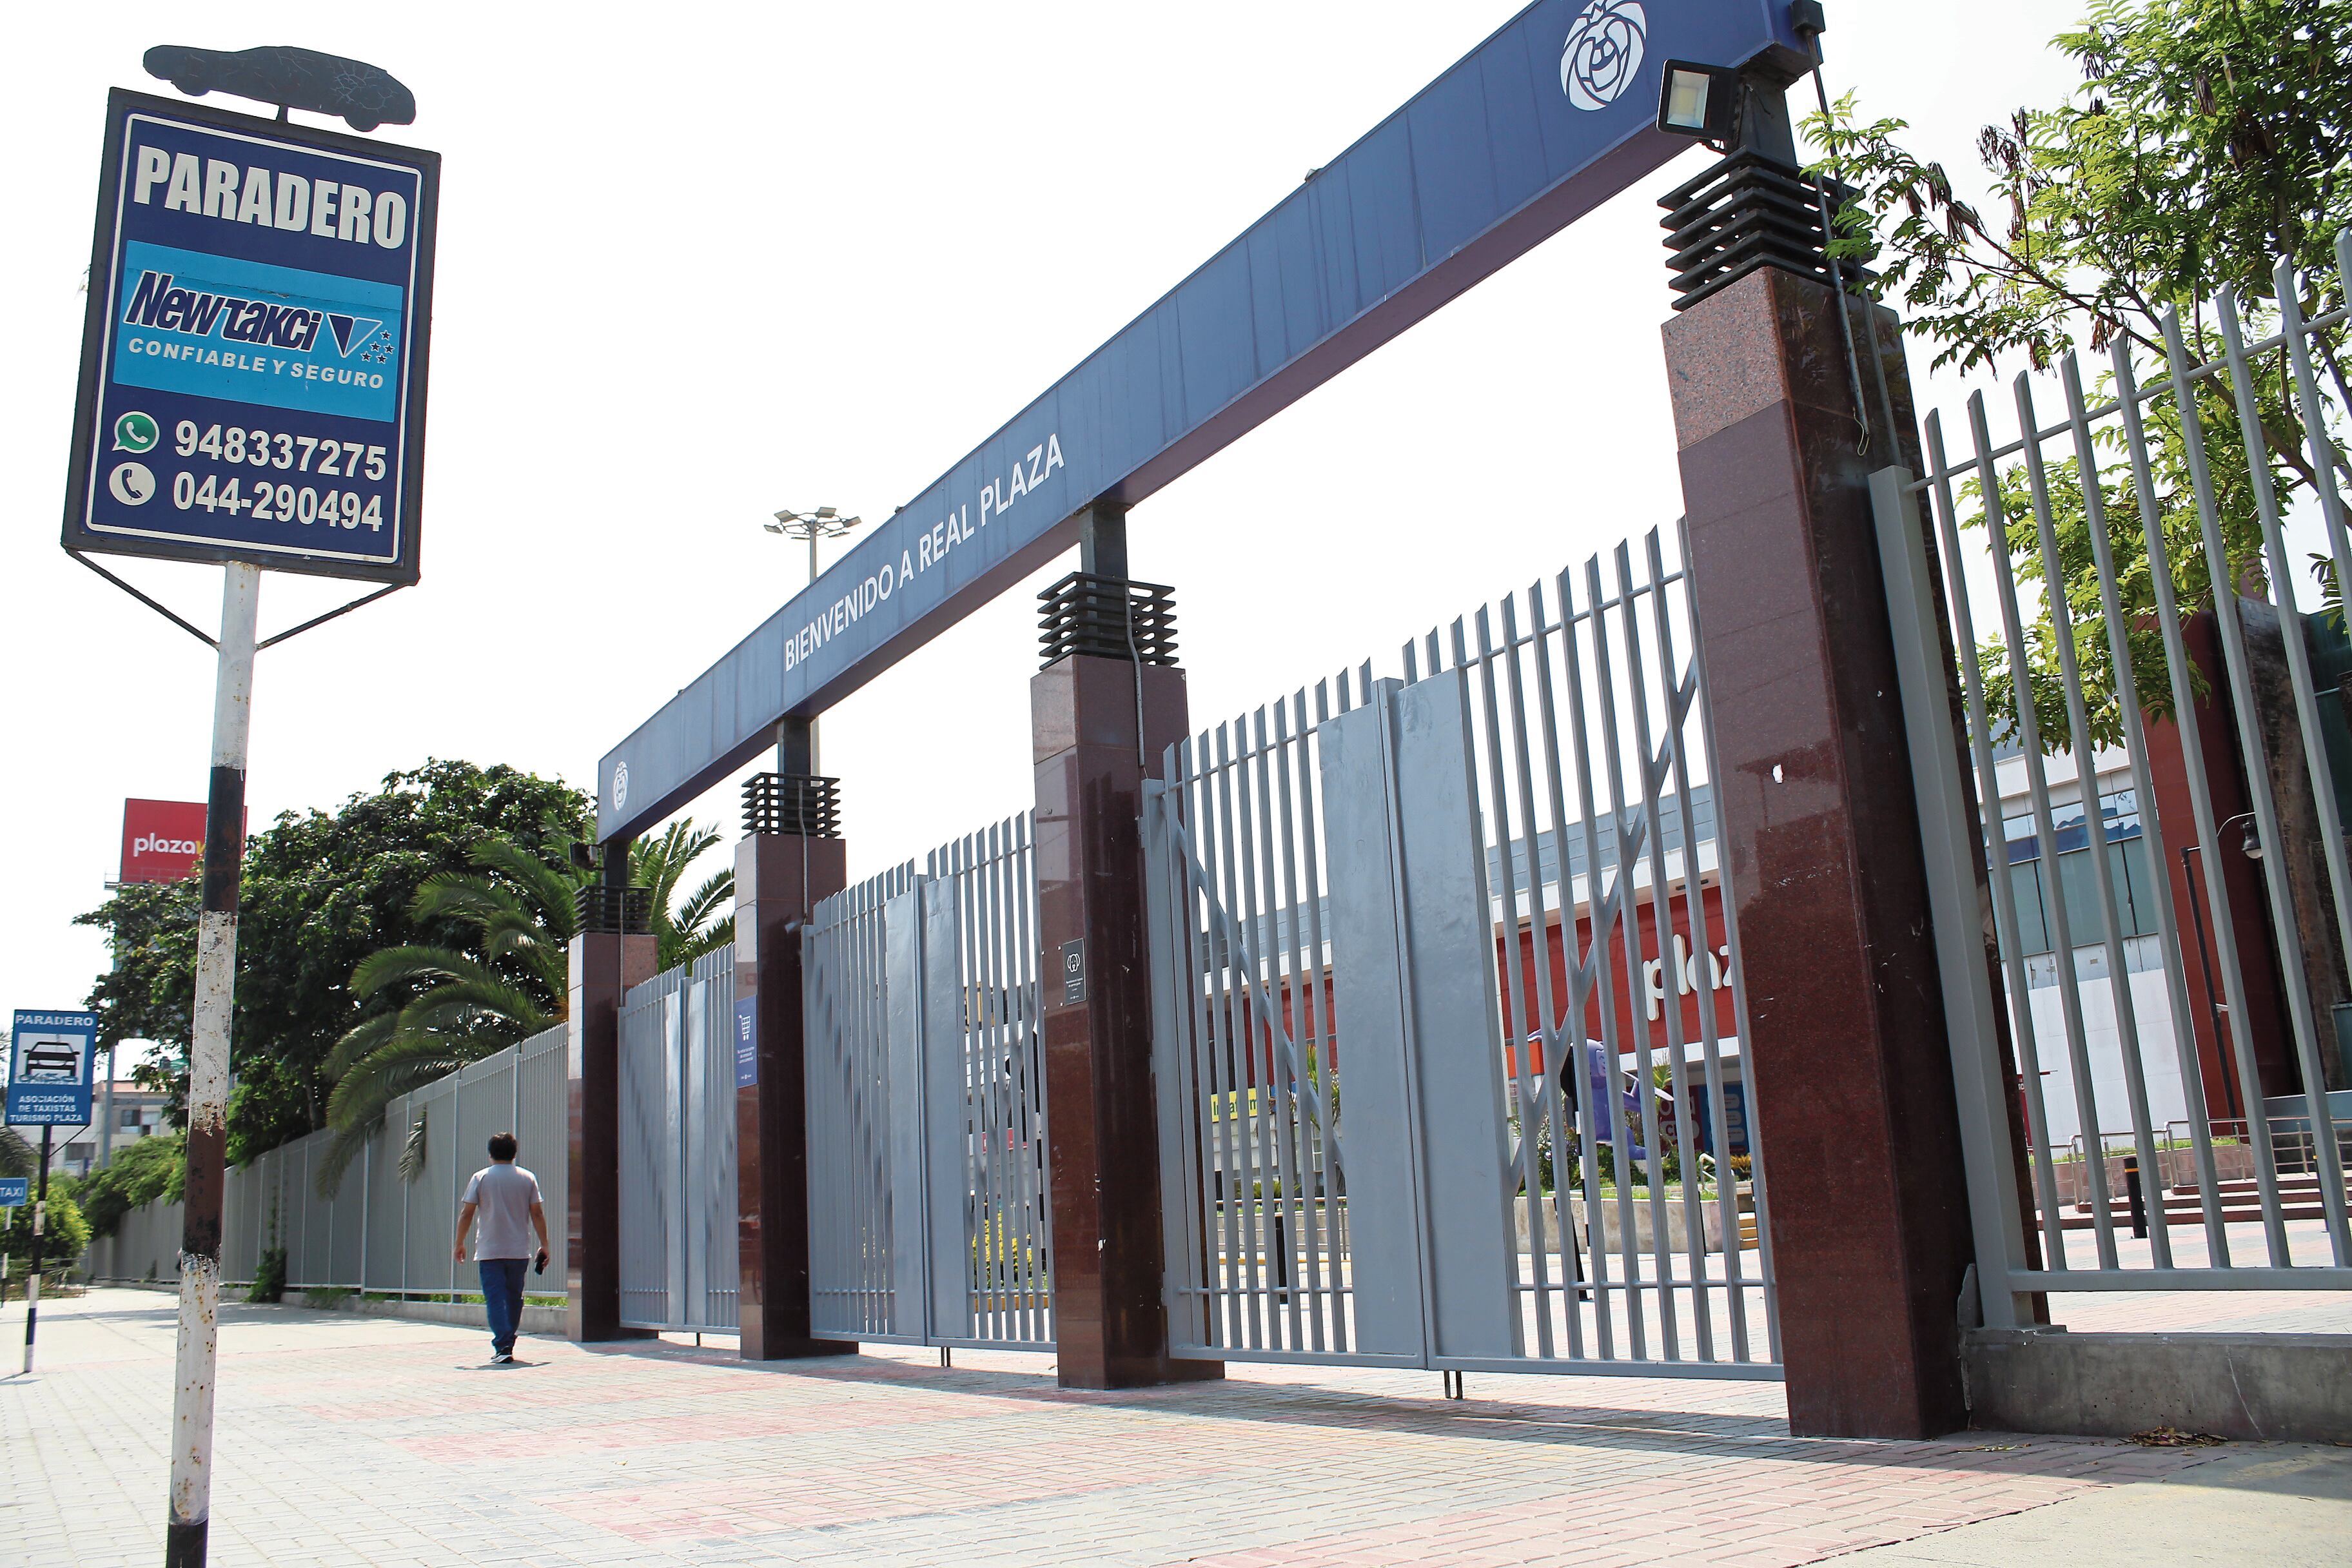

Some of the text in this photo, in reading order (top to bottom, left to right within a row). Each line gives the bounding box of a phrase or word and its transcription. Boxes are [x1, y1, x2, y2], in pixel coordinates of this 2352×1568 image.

[133, 145, 407, 250] PARADERO
[128, 338, 384, 389] CONFIABLE Y SEGURO
[175, 420, 386, 481] 948337275
[173, 471, 383, 532] 044-290494
[785, 433, 1065, 672] BIENVENIDO A REAL PLAZA
[15, 1015, 93, 1026] PARADERO
[19, 1094, 75, 1103] ASOCIACIÓN
[0, 1187, 24, 1197] TAXI
